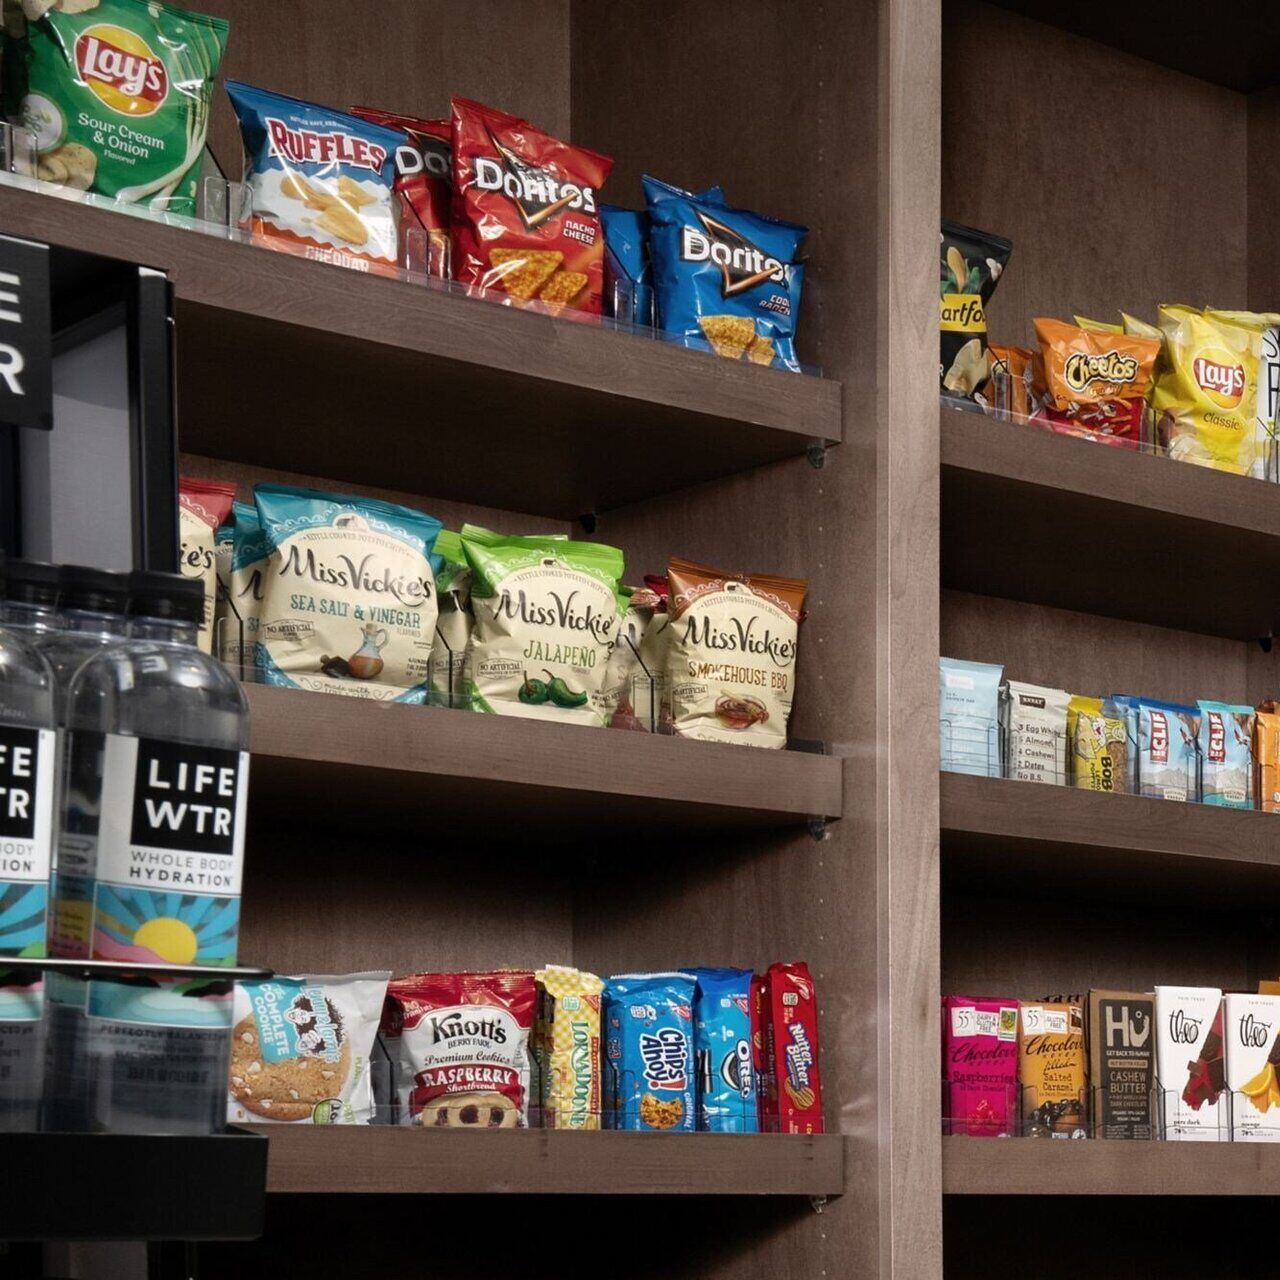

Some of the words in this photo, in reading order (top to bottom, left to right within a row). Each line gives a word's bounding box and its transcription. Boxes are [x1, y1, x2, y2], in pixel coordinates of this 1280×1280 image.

[83, 38, 162, 96] Lay's
[78, 113, 115, 132] Sour
[119, 126, 164, 149] Cream
[93, 131, 104, 145] &
[108, 135, 149, 158] Onion
[266, 117, 387, 176] RUFFLES
[475, 158, 596, 213] Doritos
[562, 228, 594, 244] CHEESE
[565, 220, 595, 236] NACHO
[1065, 351, 1140, 386] Cheetos
[1199, 358, 1244, 396] Lay's
[1203, 412, 1240, 431] Classic
[280, 545, 347, 590] Miss
[339, 554, 433, 608] Vickie's
[291, 594, 316, 613] SEA
[320, 598, 349, 617] SALT
[354, 605, 365, 620] &
[369, 606, 420, 629] VINEGAR
[524, 640, 596, 668] JALAPEÑO
[688, 660, 767, 688] SMOKEHOUSE
[771, 674, 788, 692] BBQ
[149, 758, 234, 797] LIFE
[145, 799, 230, 836] WTR
[129, 866, 231, 887] HYDRATION
[131, 850, 193, 867] WHOLE
[200, 856, 233, 871] BODY
[255, 998, 273, 1045] COOKIE
[262, 983, 290, 1055] COMPLETE
[432, 1013, 507, 1045] Knott's
[424, 1053, 473, 1066] Premium
[476, 1051, 510, 1064] Cookies
[447, 1038, 471, 1048] BERRY
[472, 1038, 492, 1048] FARM
[658, 1028, 686, 1086] Chips
[423, 1067, 514, 1086] RASPBERRY
[736, 1040, 750, 1098] OREO
[1044, 1073, 1072, 1082] Salted
[1110, 1071, 1146, 1082] CASHEW
[446, 1082, 496, 1092] Shortbread
[1042, 1082, 1073, 1092] Caramel
[1110, 1082, 1146, 1094] BUTTER
